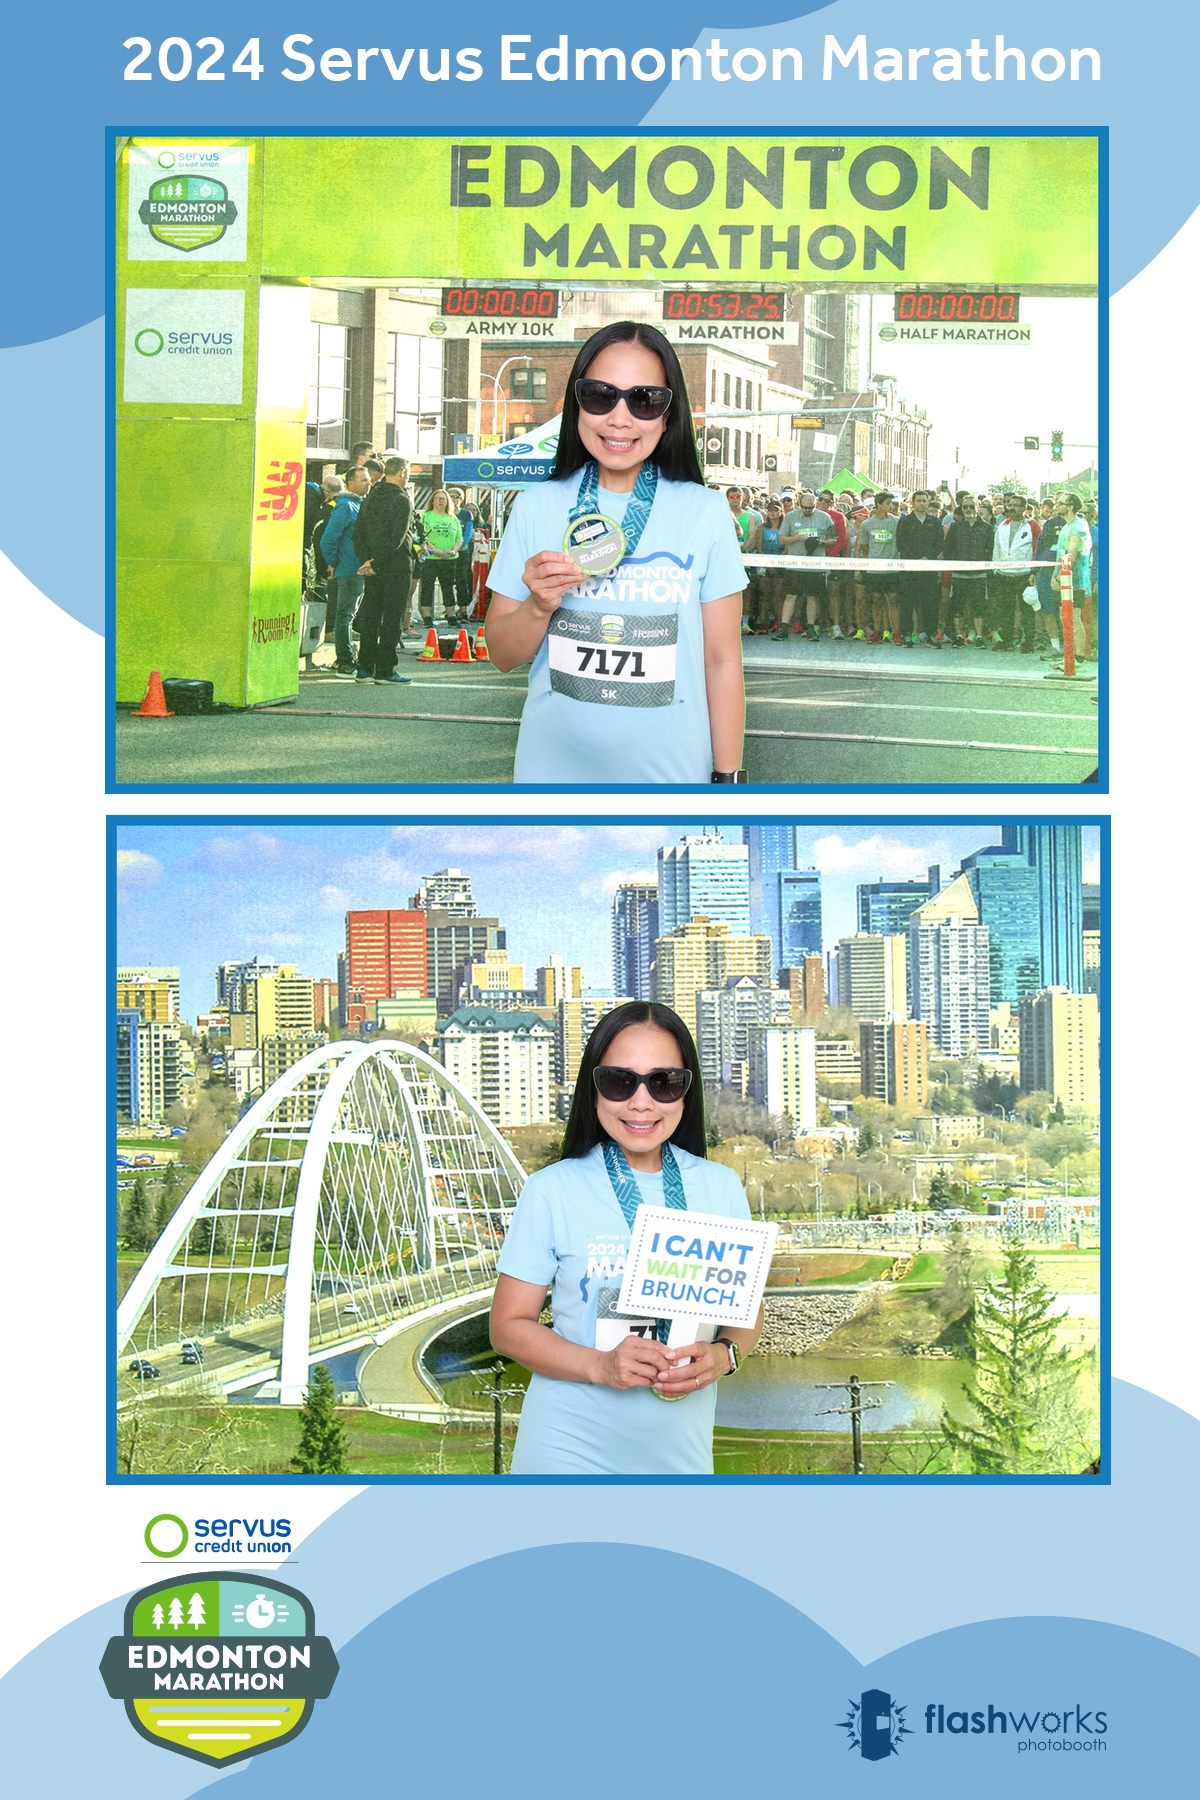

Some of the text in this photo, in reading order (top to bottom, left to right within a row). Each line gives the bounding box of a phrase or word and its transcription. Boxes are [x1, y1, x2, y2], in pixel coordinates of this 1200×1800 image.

[178, 152, 219, 161] servus
[450, 144, 990, 211] EDMONTON
[149, 202, 227, 214] EDMONTON
[160, 214, 215, 222] MARATHON
[523, 223, 906, 271] MARATHON
[466, 321, 555, 337] ARMY 10K
[678, 325, 785, 340] MARATHON
[900, 328, 939, 340] HALF
[942, 328, 1031, 341] MARATHON
[168, 331, 233, 345] servus
[168, 345, 233, 355] credit union
[496, 465, 546, 475] servus
[598, 565, 693, 583] DMONTON
[257, 613, 291, 643] Running
[576, 646, 646, 678] 7171
[601, 689, 618, 699] 5K
[595, 1232, 620, 1241] servus
[586, 1242, 626, 1257] 2024
[651, 1233, 754, 1265] I CAN'T
[647, 1258, 703, 1281] WAIT
[705, 1266, 747, 1287] FOR
[641, 1279, 740, 1308] BRUNCH.
